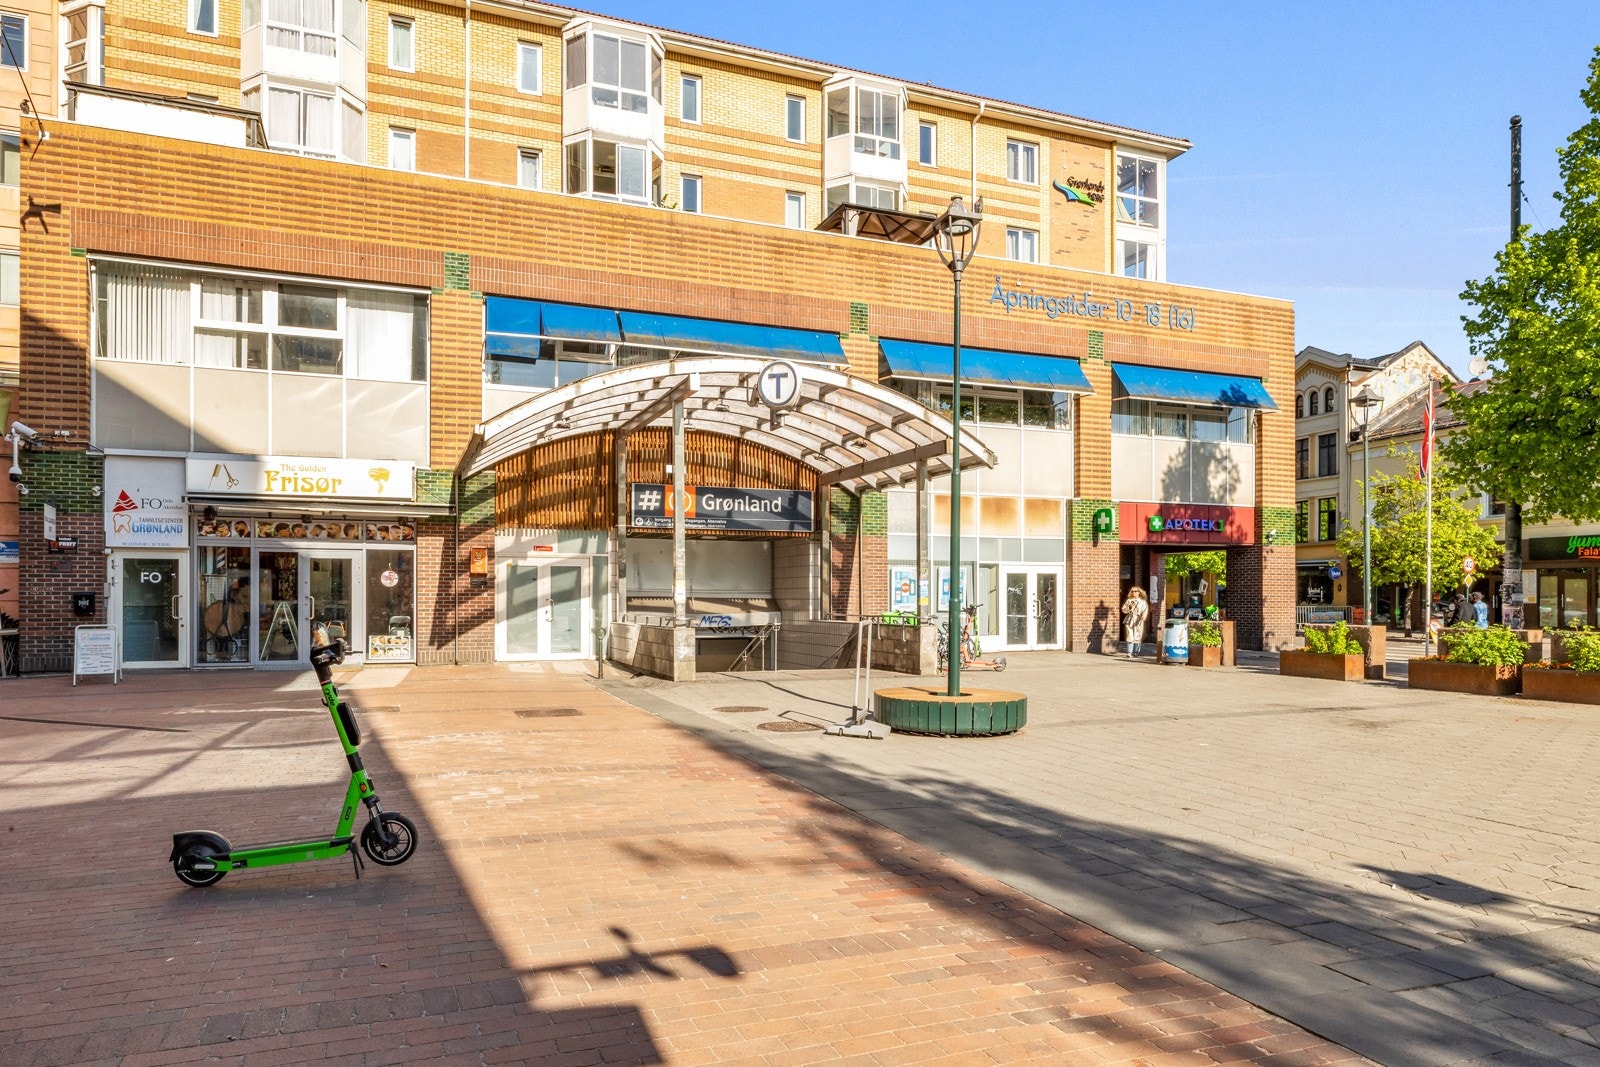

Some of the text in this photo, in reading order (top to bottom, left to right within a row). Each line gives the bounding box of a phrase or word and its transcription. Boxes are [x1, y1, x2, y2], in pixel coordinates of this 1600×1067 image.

[990, 275, 1112, 320] Åpningstider:
[1115, 298, 1133, 321] 10
[1145, 303, 1162, 326] 18
[1169, 303, 1195, 332] (16)
[768, 372, 789, 399] T
[280, 463, 327, 474] The Golden
[264, 470, 342, 493] Frisør
[140, 498, 162, 510] FO
[702, 494, 783, 513] Grønland
[131, 522, 183, 535] GRØNLAND
[1164, 518, 1215, 532] APOTEK
[1578, 547, 1600, 556] Fala
[1465, 560, 1473, 569] 40
[141, 571, 162, 584] FO
